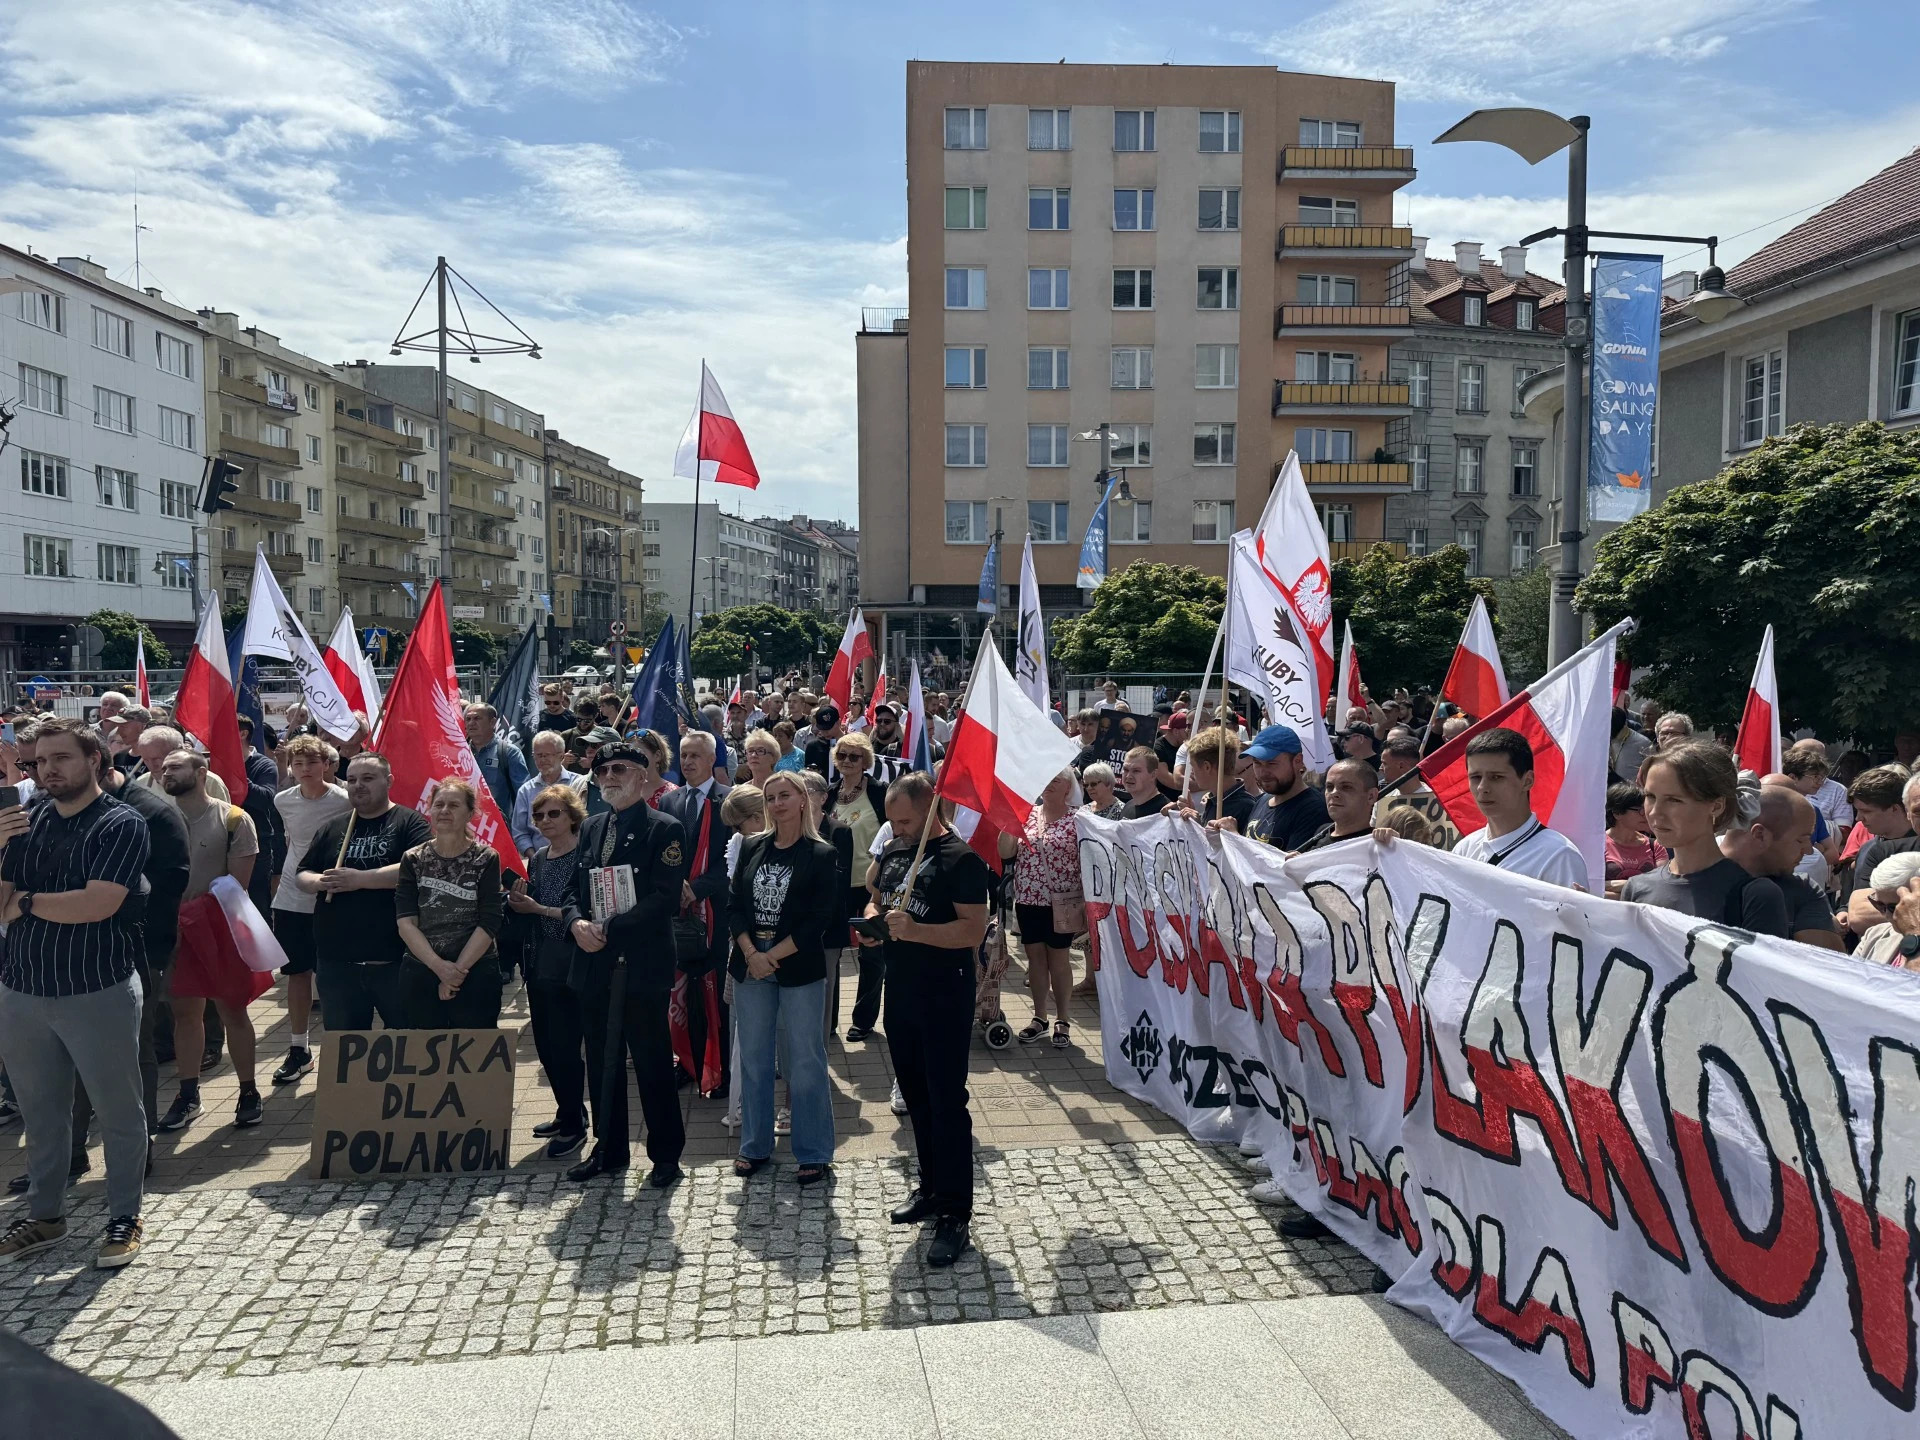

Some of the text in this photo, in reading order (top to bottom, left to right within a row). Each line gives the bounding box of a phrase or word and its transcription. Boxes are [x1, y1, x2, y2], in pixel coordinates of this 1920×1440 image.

[1602, 342, 1647, 356] GDYNIA
[1600, 380, 1656, 396] GDYNIA
[1600, 400, 1655, 416] SAILING
[1110, 748, 1126, 761] STO
[356, 835, 378, 846] THE
[424, 879, 476, 900] CHOCOLATE
[336, 1033, 512, 1084] POLSKA
[381, 1081, 466, 1121] DLA
[320, 1119, 508, 1180] POLAKÓW
[1420, 1185, 1596, 1389] DLA
